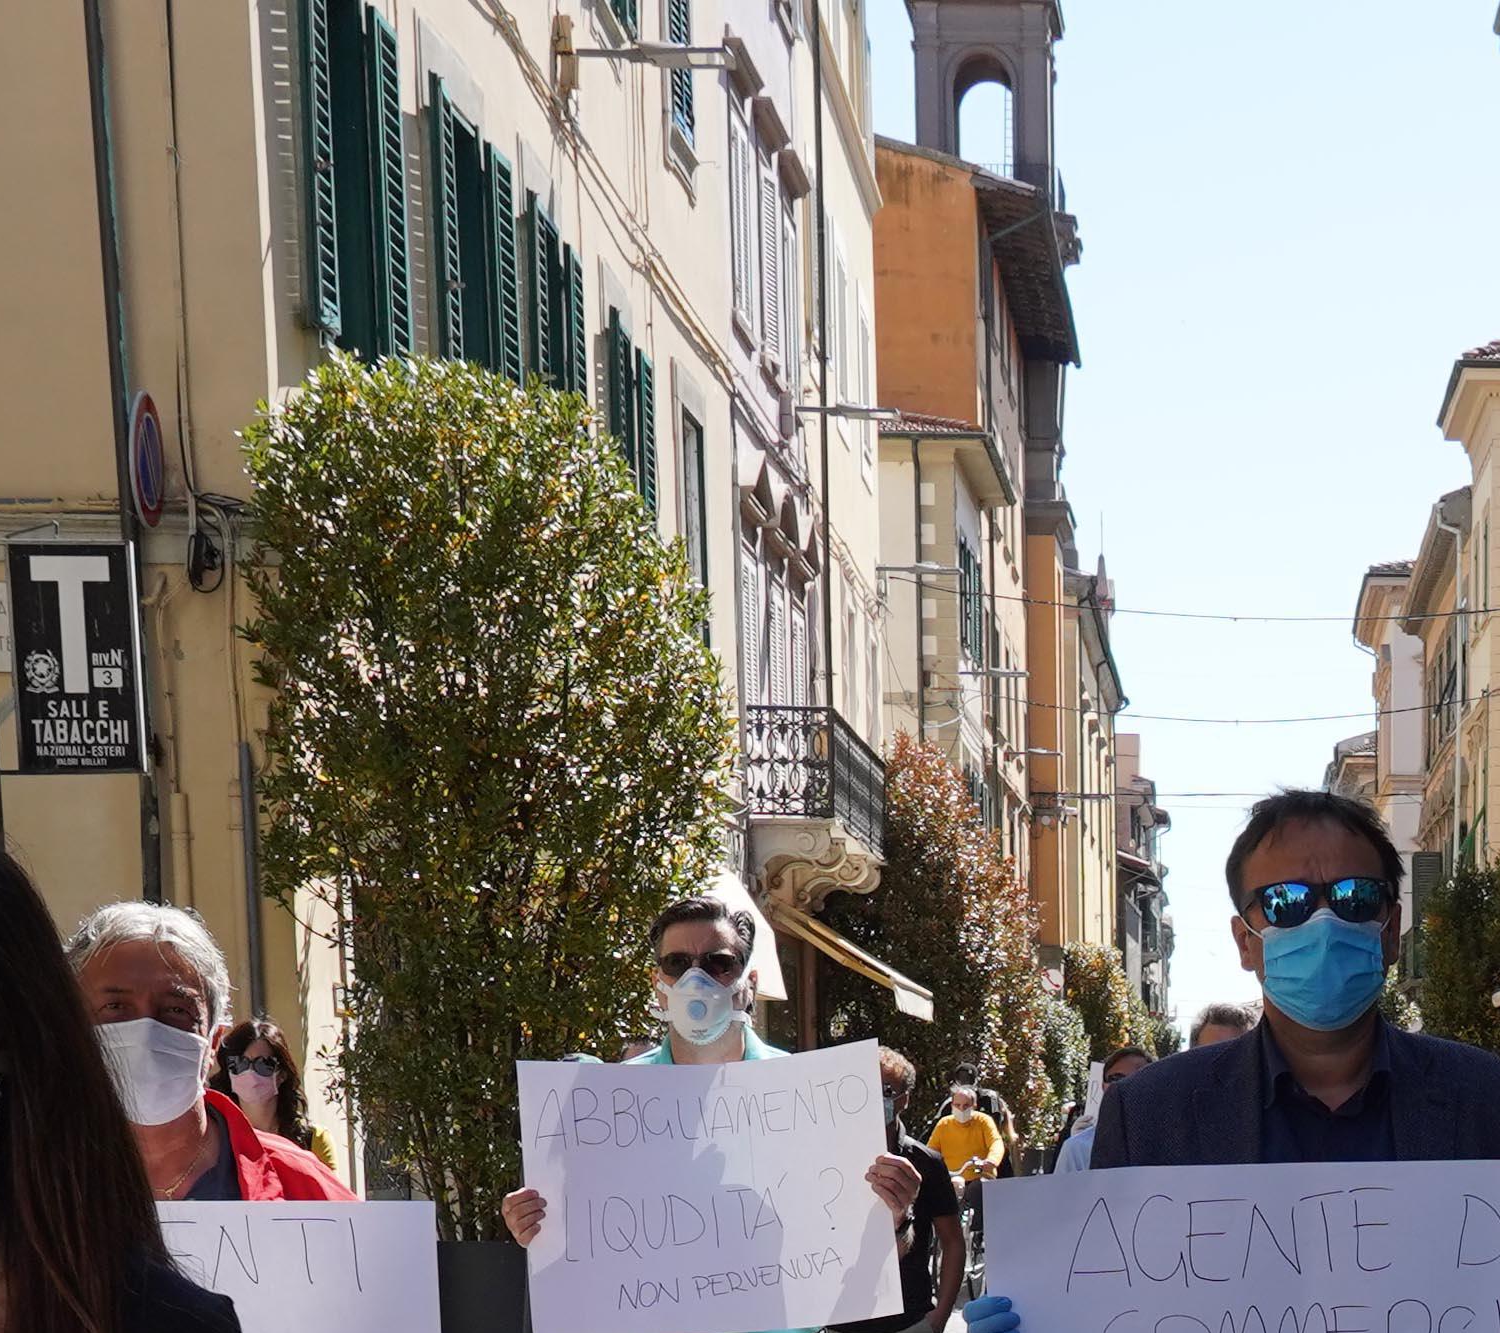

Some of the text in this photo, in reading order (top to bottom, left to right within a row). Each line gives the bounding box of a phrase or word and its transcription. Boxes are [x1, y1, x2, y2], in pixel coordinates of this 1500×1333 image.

[29, 555, 110, 694] T
[48, 700, 110, 718] SALI E
[102, 670, 113, 686] 3
[31, 720, 130, 745] TABACCHI
[534, 1074, 870, 1150] ABBIGLIAMENTO
[818, 1167, 845, 1231] ?
[1066, 1186, 1396, 1293] AGENTE
[617, 1246, 844, 1311] NON PERVENUTA
